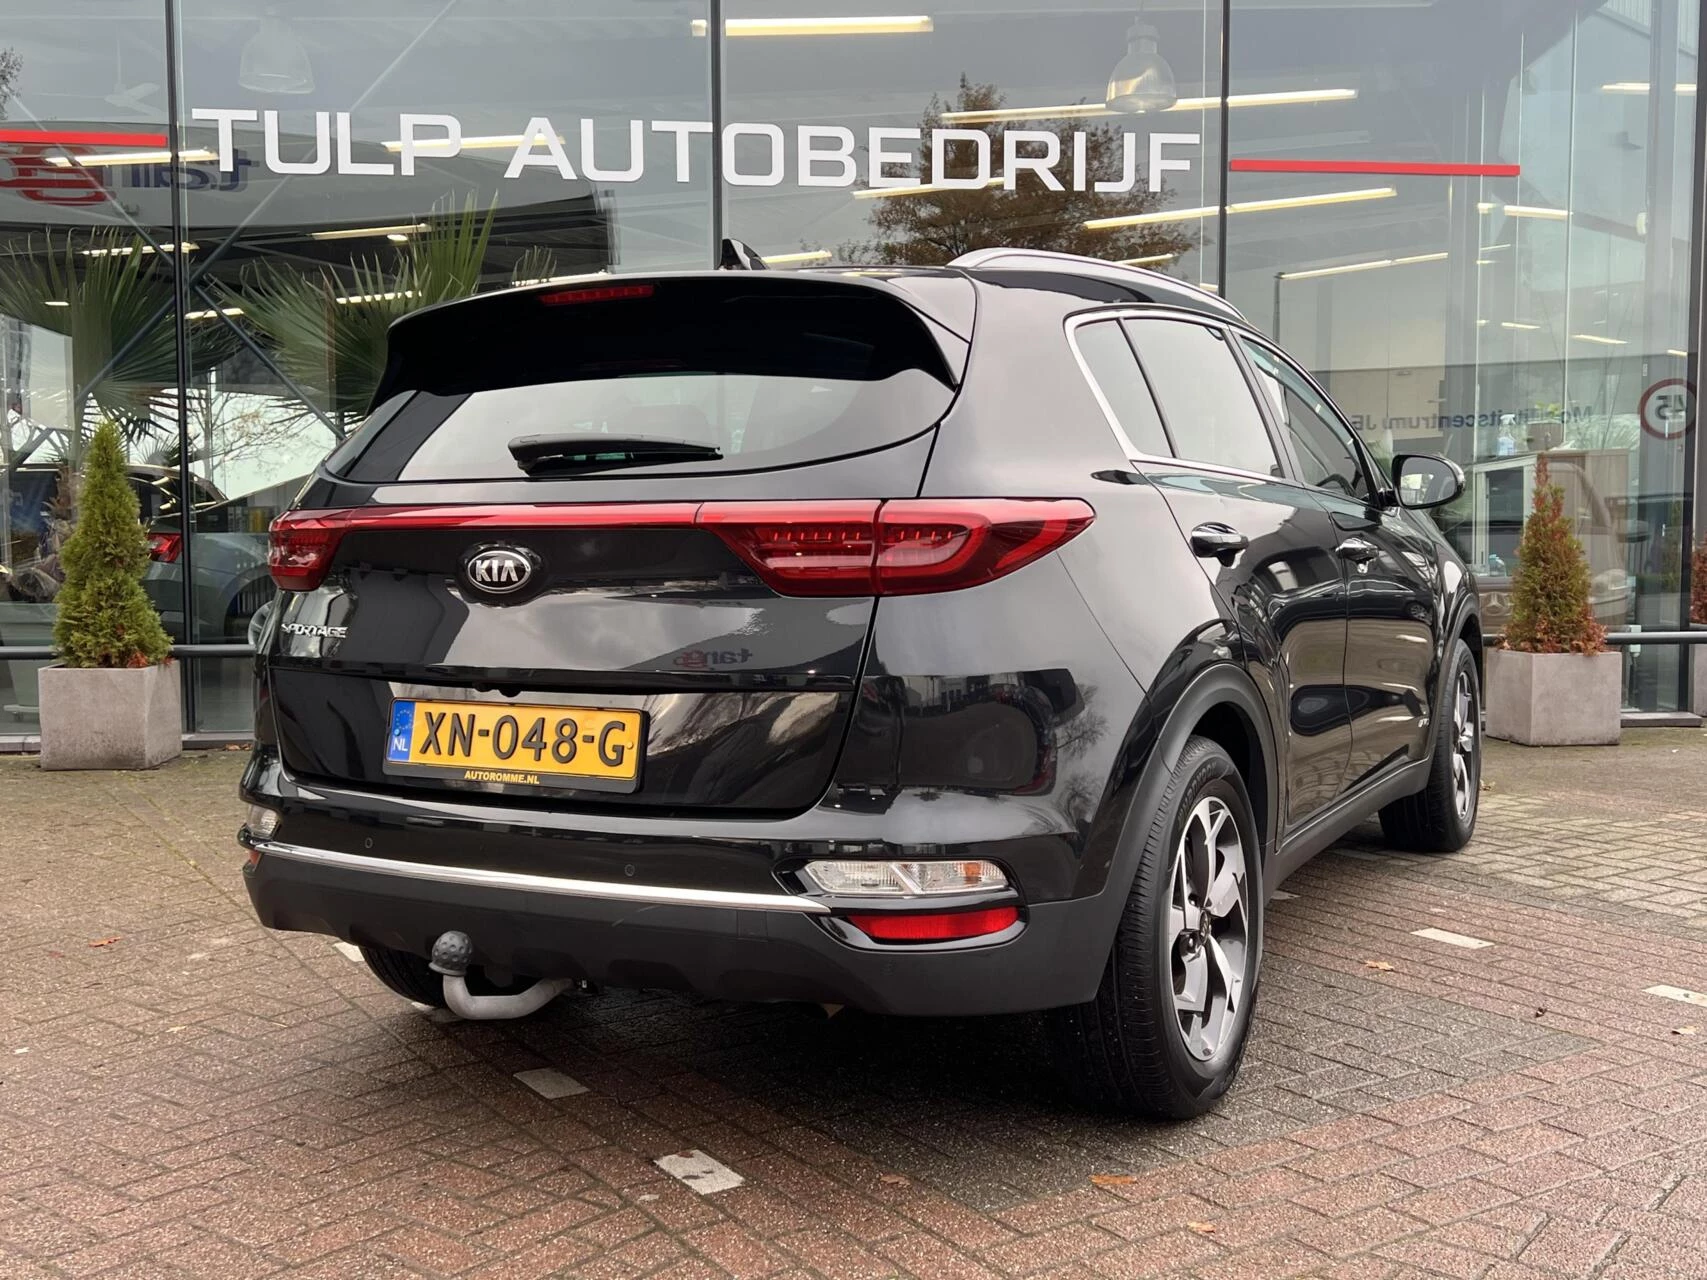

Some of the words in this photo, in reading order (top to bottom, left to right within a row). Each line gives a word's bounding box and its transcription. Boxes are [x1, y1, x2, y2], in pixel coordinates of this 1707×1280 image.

[191, 107, 462, 177] TULP
[503, 116, 1201, 194] AUTOBEDRIJF
[475, 559, 519, 582] KIA
[281, 623, 348, 639] SPORTAGE
[393, 738, 408, 753] NL
[419, 711, 626, 767] XN-048-G
[464, 769, 540, 785] AUTOROMME.NL
